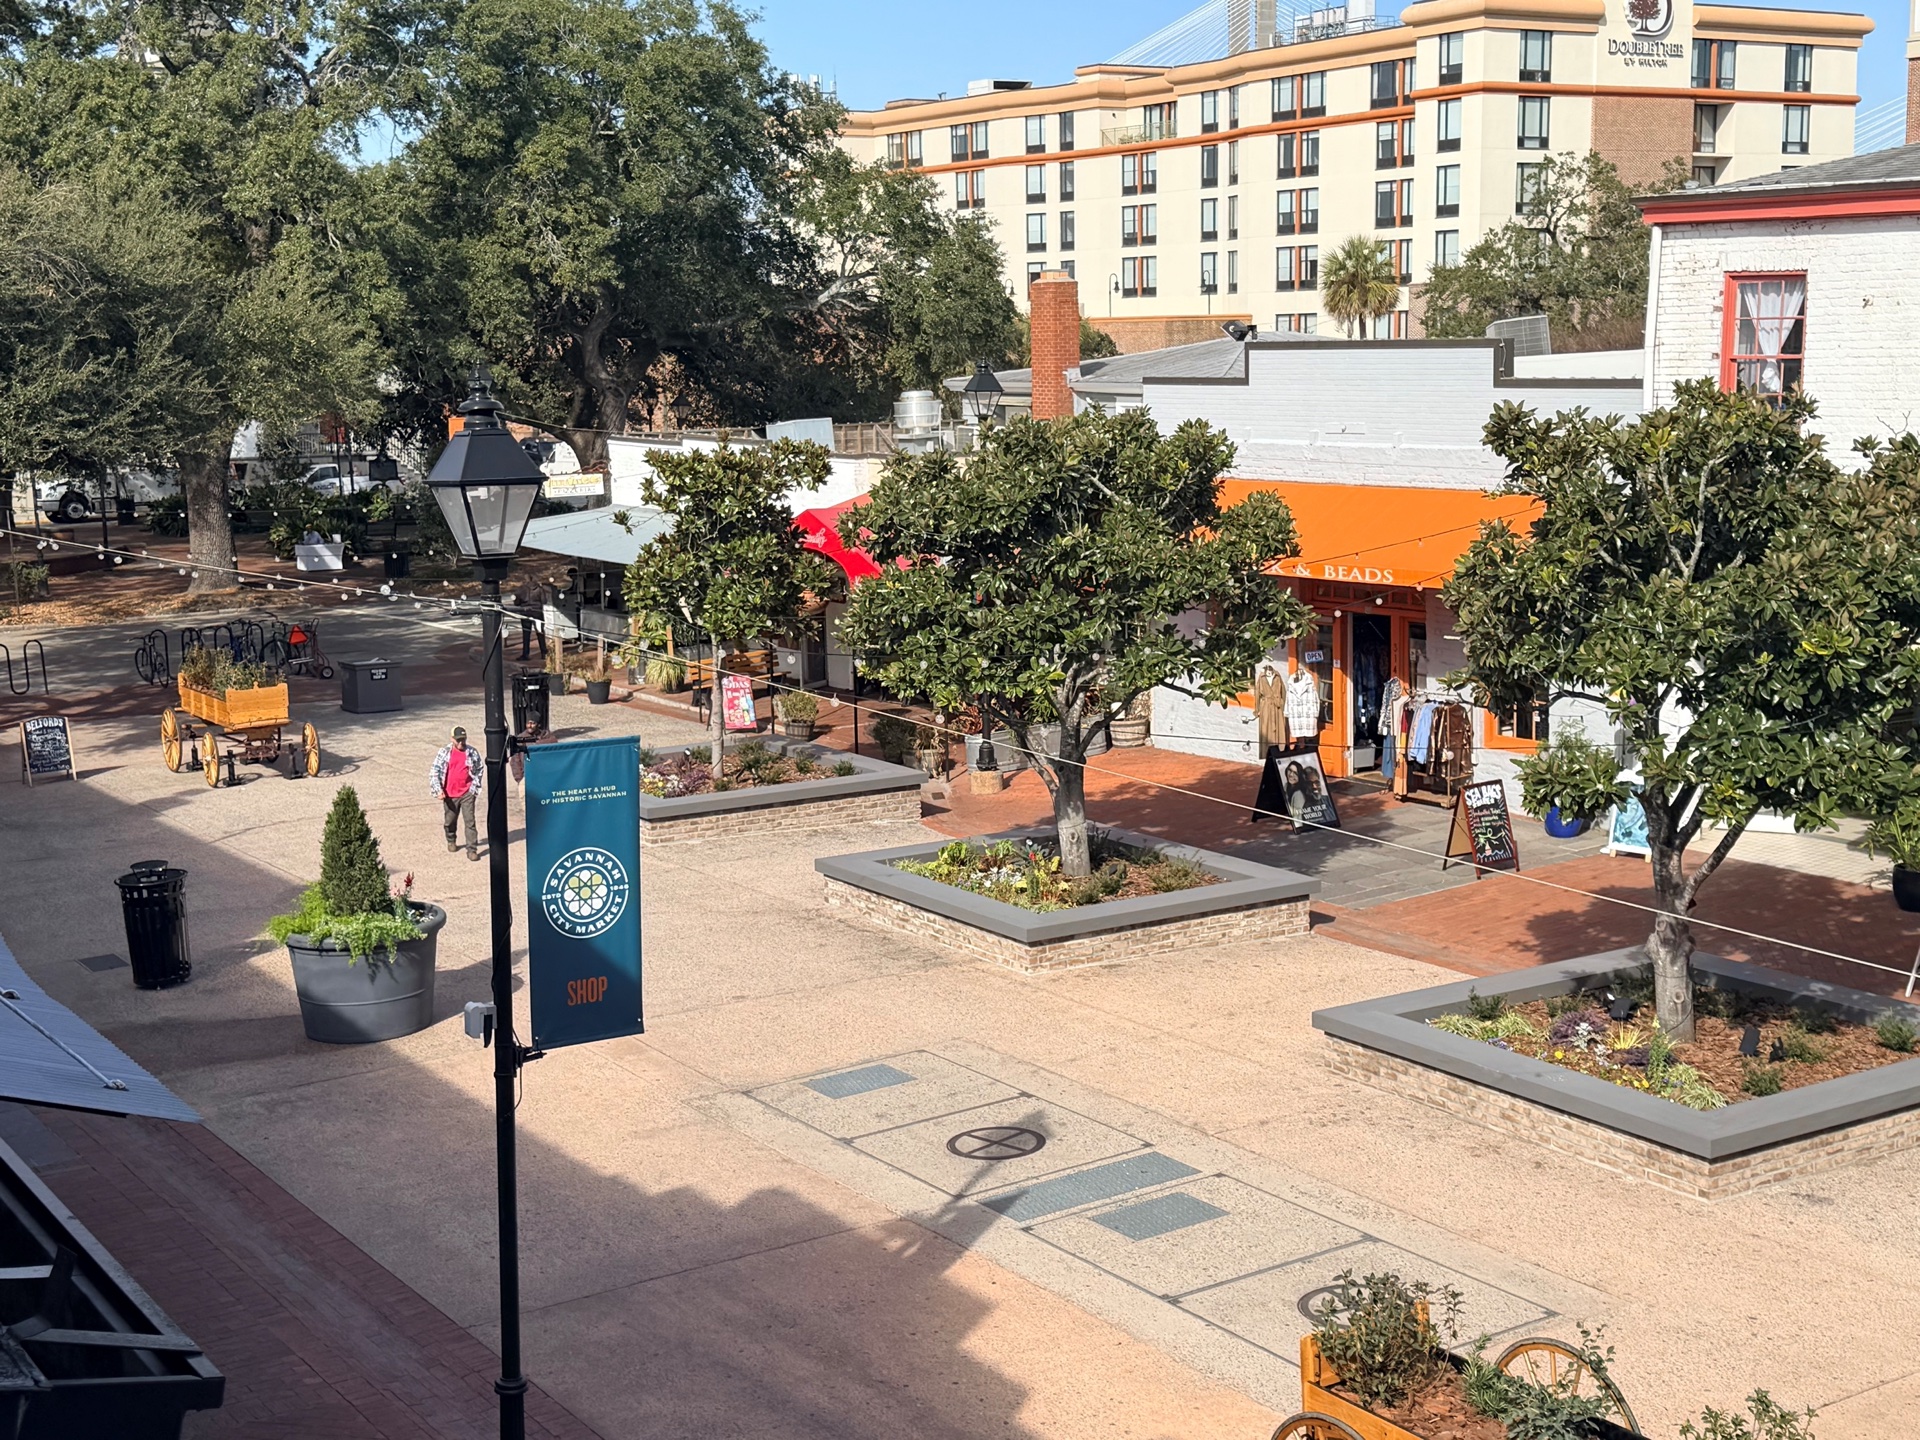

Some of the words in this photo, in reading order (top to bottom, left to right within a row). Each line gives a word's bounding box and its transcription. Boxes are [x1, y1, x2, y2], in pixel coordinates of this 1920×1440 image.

[1624, 57, 1635, 67] BY
[1638, 58, 1668, 68] HILTON
[1296, 562, 1312, 577] &
[1324, 565, 1394, 583] BEADS
[1307, 652, 1322, 661] OPEN
[25, 717, 64, 732] BELFORDS
[552, 796, 587, 804] HISTORIC
[588, 791, 627, 800] SAVANNAH
[568, 787, 592, 795] HEART
[1465, 786, 1482, 805] SEA
[1482, 784, 1502, 799] BAGS
[1312, 803, 1327, 811] YOUR
[1304, 811, 1322, 819] WORLD
[550, 853, 621, 887] SAVANNAH
[549, 904, 573, 930] CITY
[575, 895, 622, 934] MARKET
[567, 976, 608, 1006] SHOP
